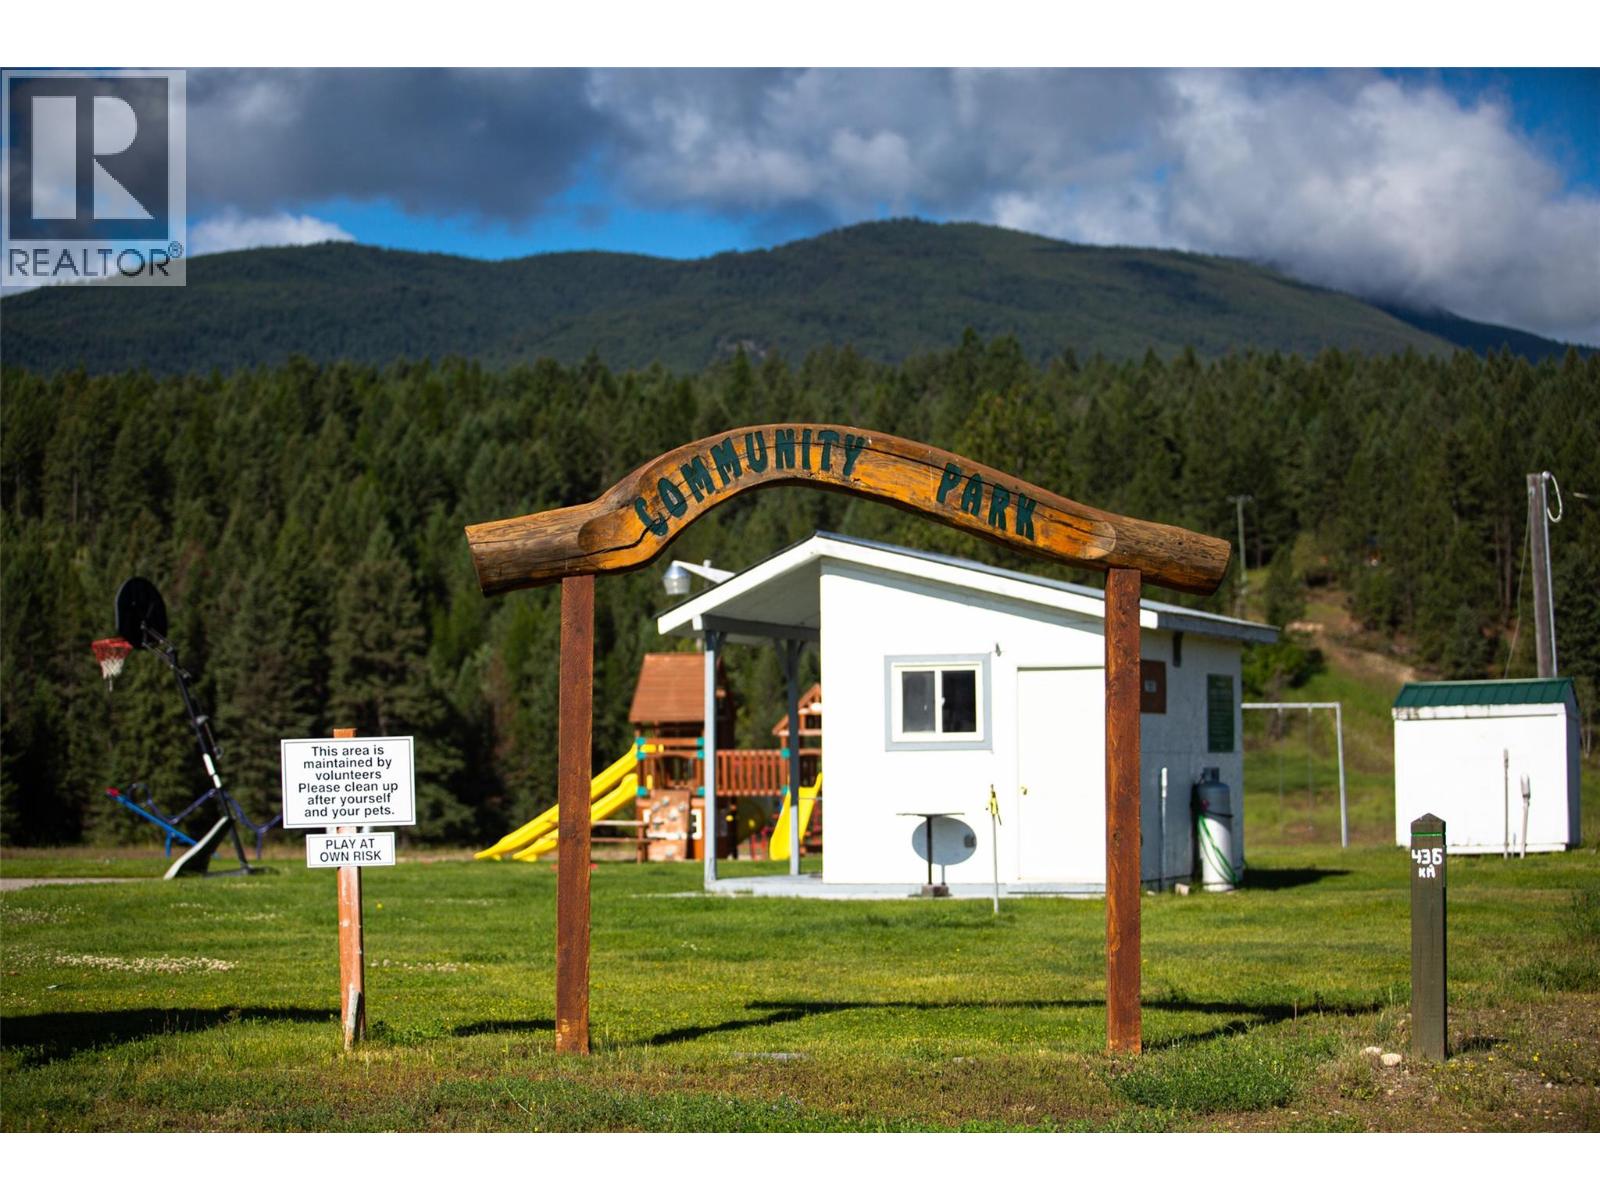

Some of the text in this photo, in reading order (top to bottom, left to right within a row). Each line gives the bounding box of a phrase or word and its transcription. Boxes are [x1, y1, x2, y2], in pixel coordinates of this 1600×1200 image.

[634, 428, 1036, 541] COMMUNITY PARK
[311, 745, 384, 757] This area is
[303, 757, 392, 769] maintained by
[315, 770, 382, 781] volunteers
[298, 782, 398, 793] Please clean up
[307, 793, 391, 807] after yourself
[304, 806, 395, 819] and your pets.
[325, 838, 375, 850] PLAY AT
[320, 850, 382, 863] OWN RISK
[1411, 848, 1443, 865] 436
